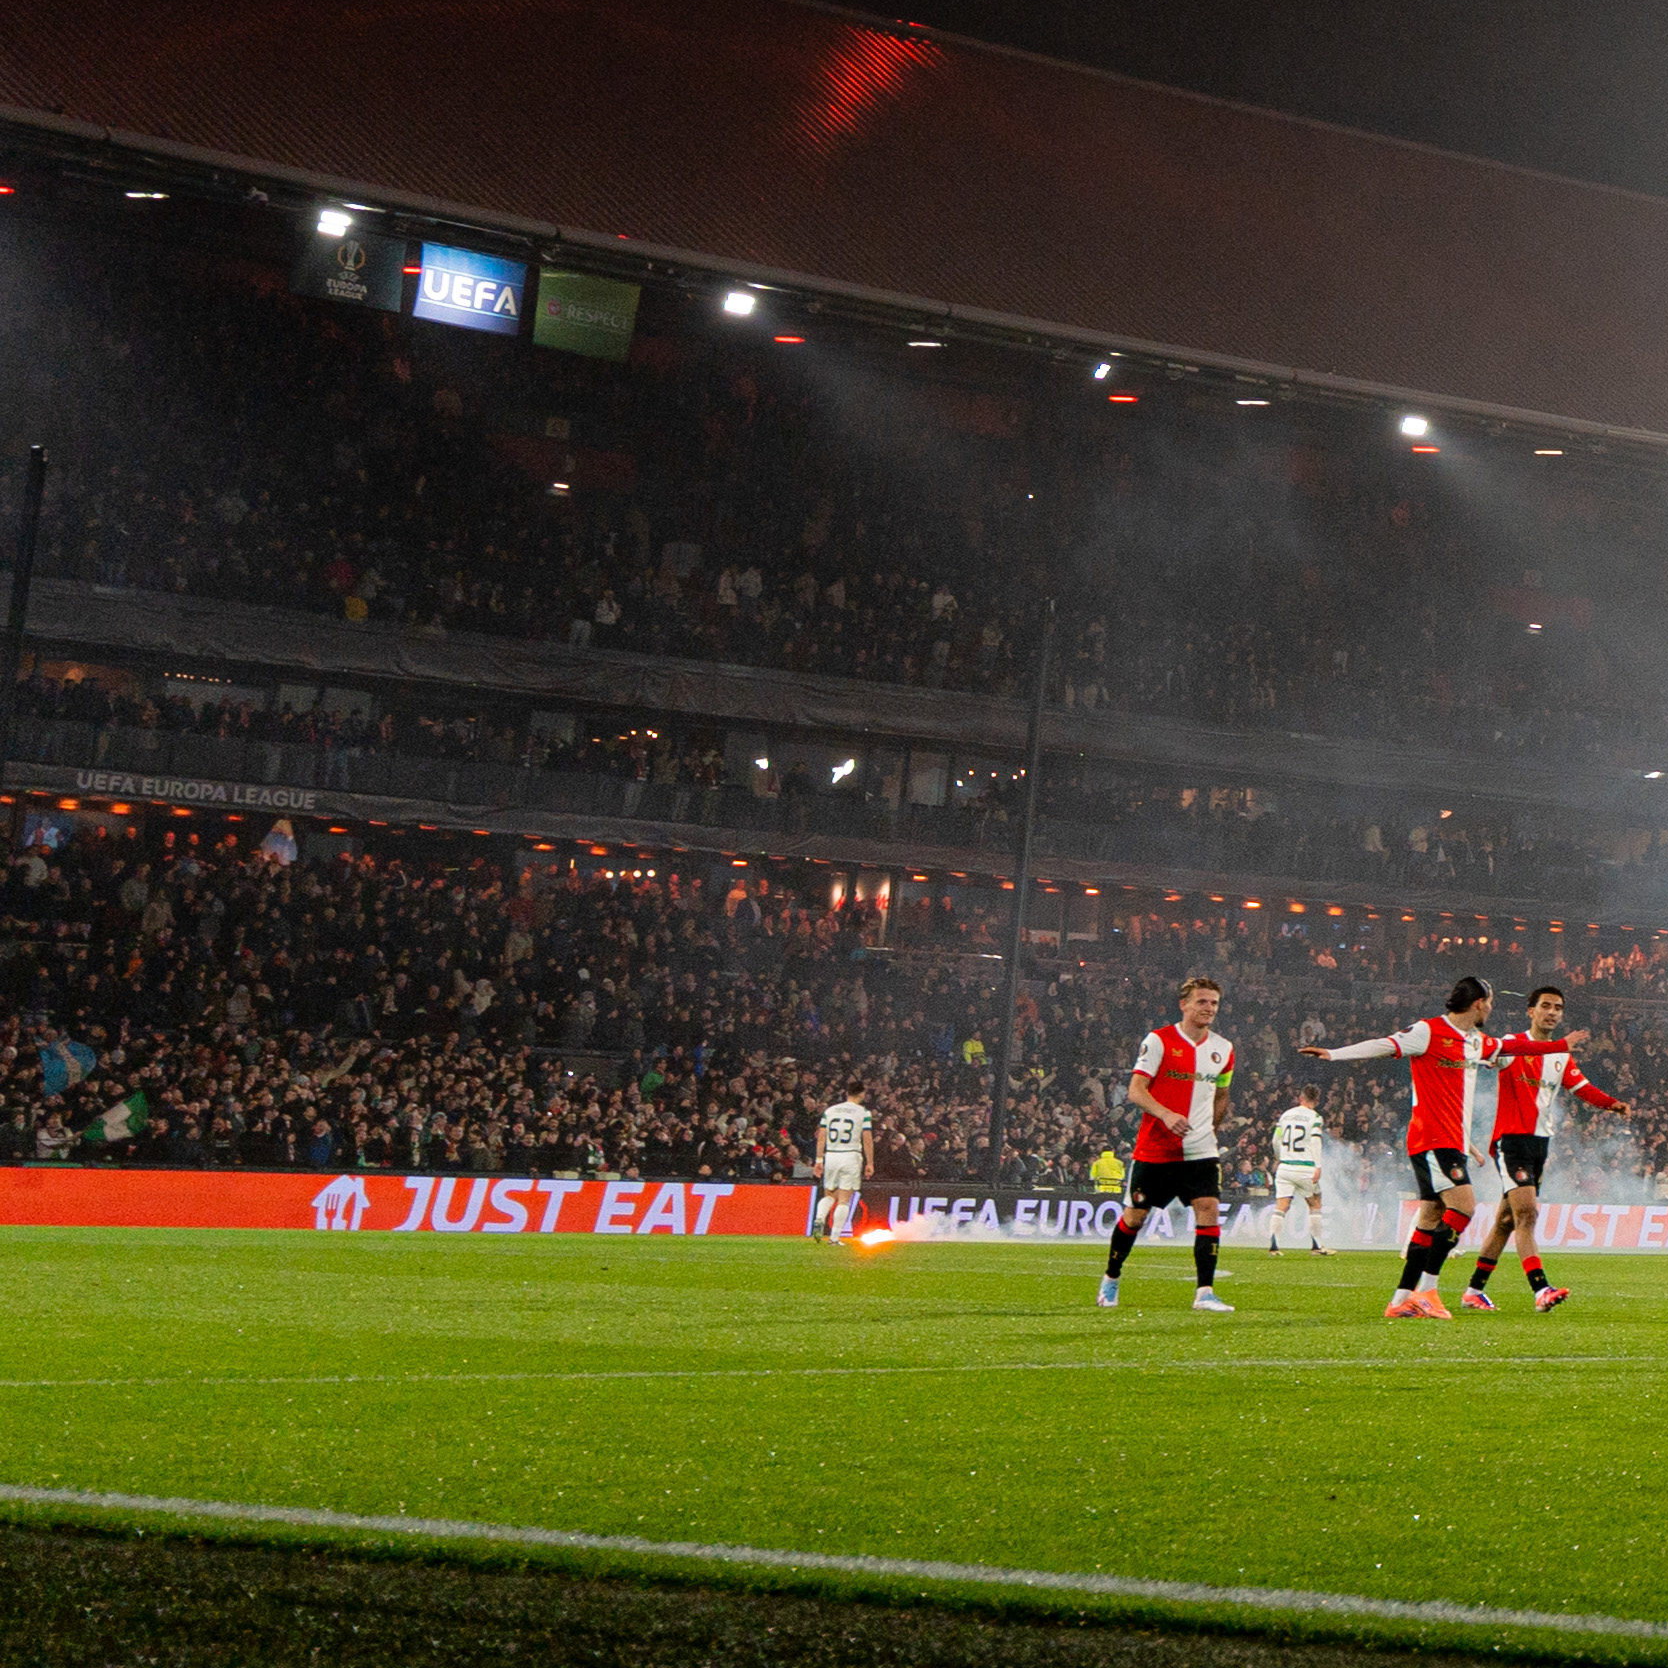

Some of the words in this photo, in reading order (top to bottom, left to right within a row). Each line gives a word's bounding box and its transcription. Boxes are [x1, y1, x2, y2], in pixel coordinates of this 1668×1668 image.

[423, 269, 518, 316] UEFA
[77, 772, 136, 794] UEFA
[141, 779, 228, 802] EUROPA
[233, 787, 317, 810] LEAGUE
[829, 1118, 855, 1144] 63
[1282, 1124, 1306, 1152] 42
[392, 1176, 583, 1234] JUST
[594, 1181, 735, 1235] EAT
[888, 1196, 1000, 1234] UEFA
[1015, 1199, 1175, 1240] EUROA
[1534, 1204, 1629, 1248] UST
